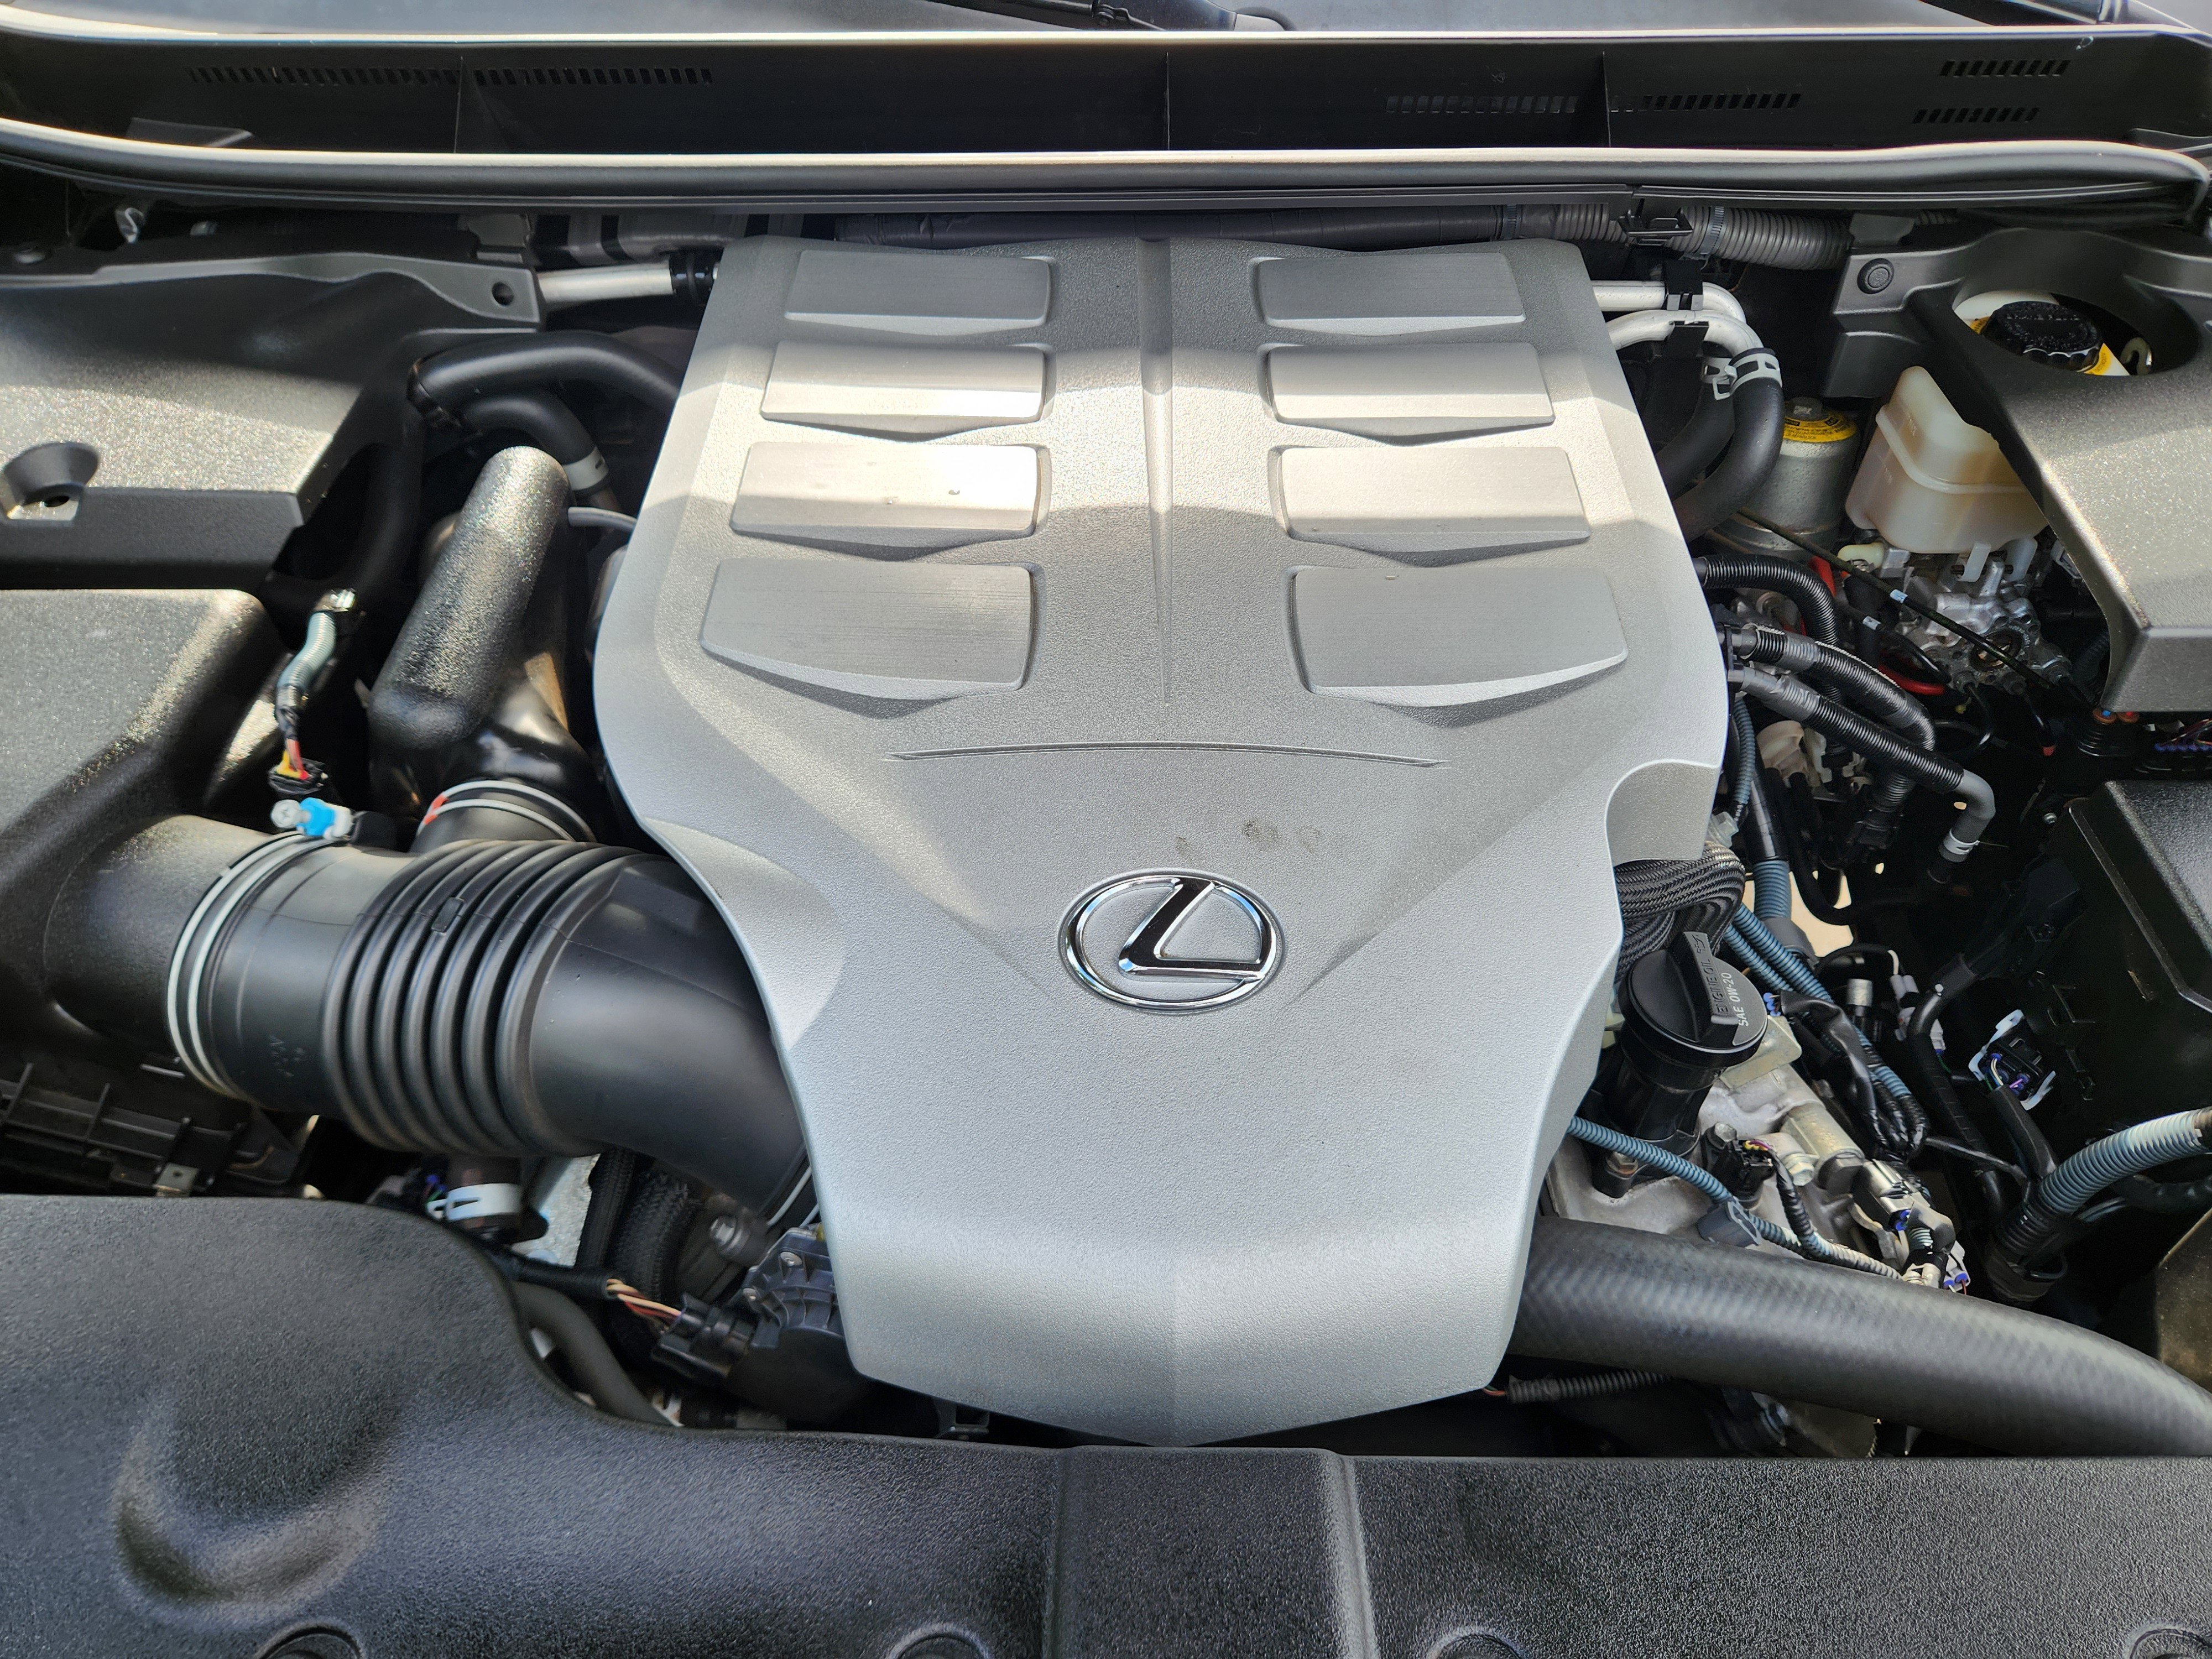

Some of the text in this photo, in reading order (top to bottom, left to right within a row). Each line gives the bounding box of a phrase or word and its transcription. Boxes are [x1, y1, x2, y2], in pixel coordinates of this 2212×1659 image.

[1700, 958, 1729, 1014] ENGINE OIL
[1720, 973, 1749, 1026] SAE 0W-20
